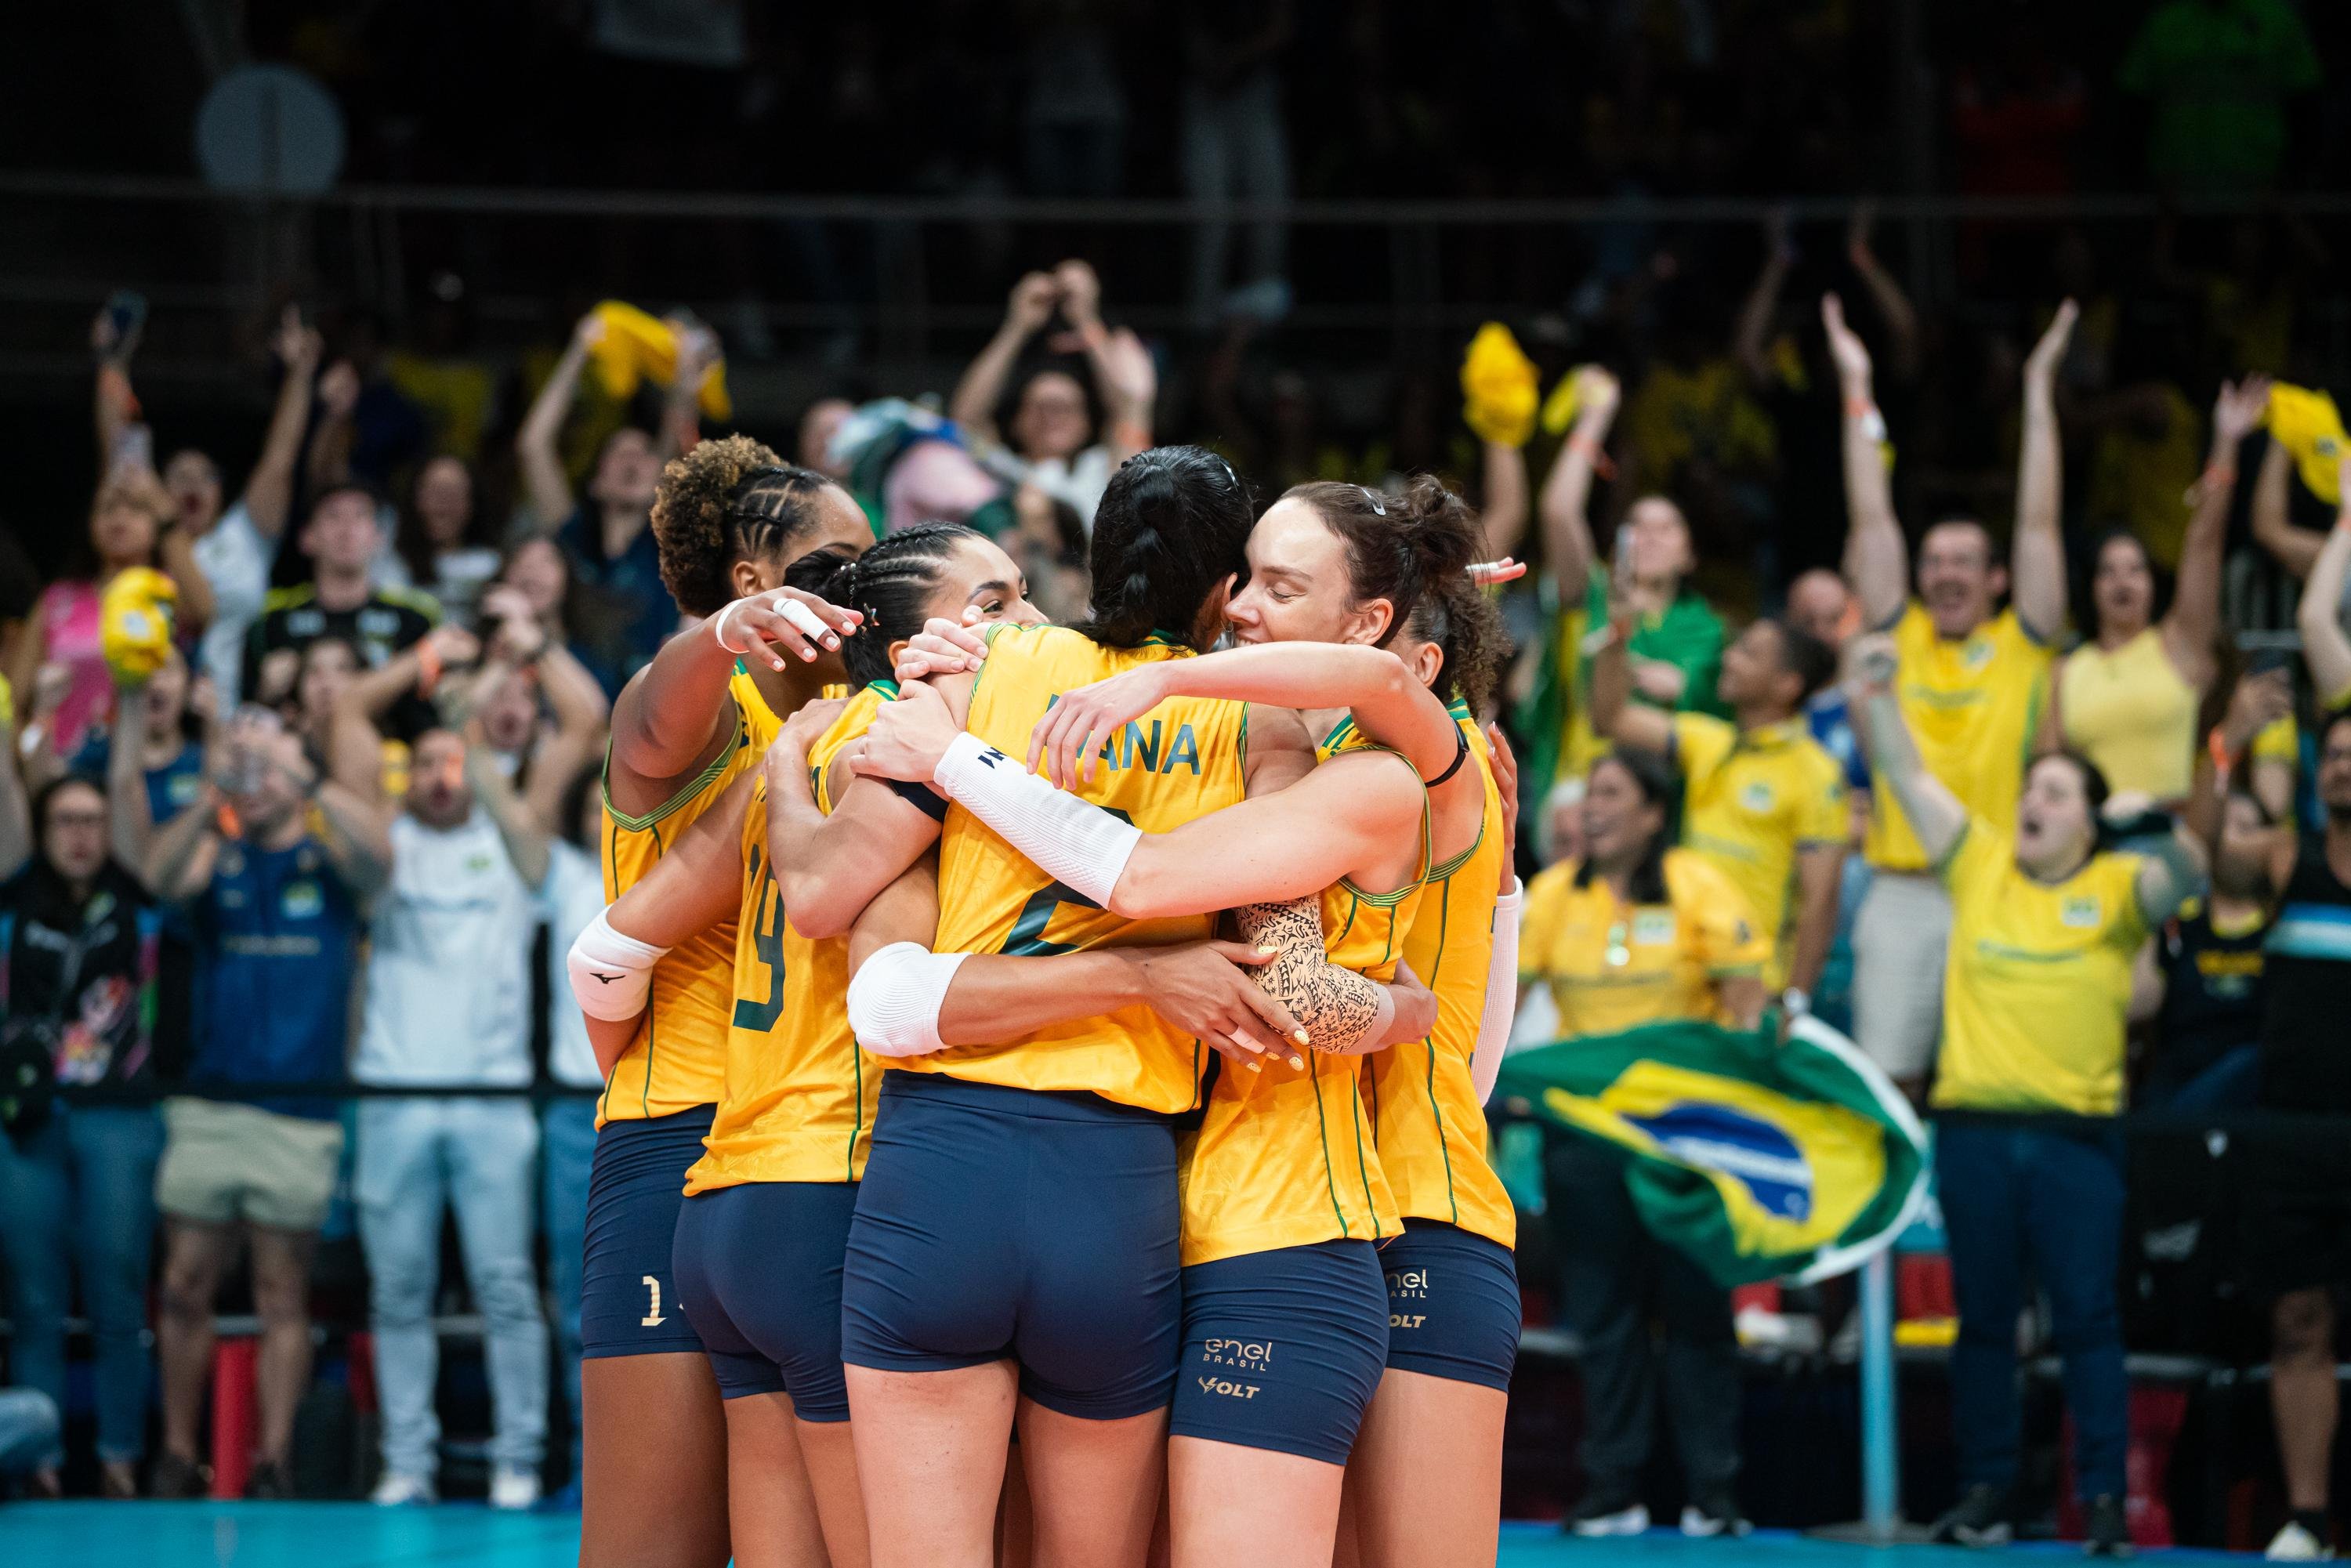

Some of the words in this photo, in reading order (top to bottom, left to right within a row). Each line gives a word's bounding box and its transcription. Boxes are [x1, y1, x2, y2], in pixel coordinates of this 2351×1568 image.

[1386, 1269, 1429, 1289] nel
[1390, 1290, 1426, 1298] ASIL
[1389, 1314, 1427, 1328] OLT
[1205, 1338, 1273, 1362] enel
[1203, 1353, 1266, 1372] BRASIL
[1197, 1376, 1261, 1400] VOLT
